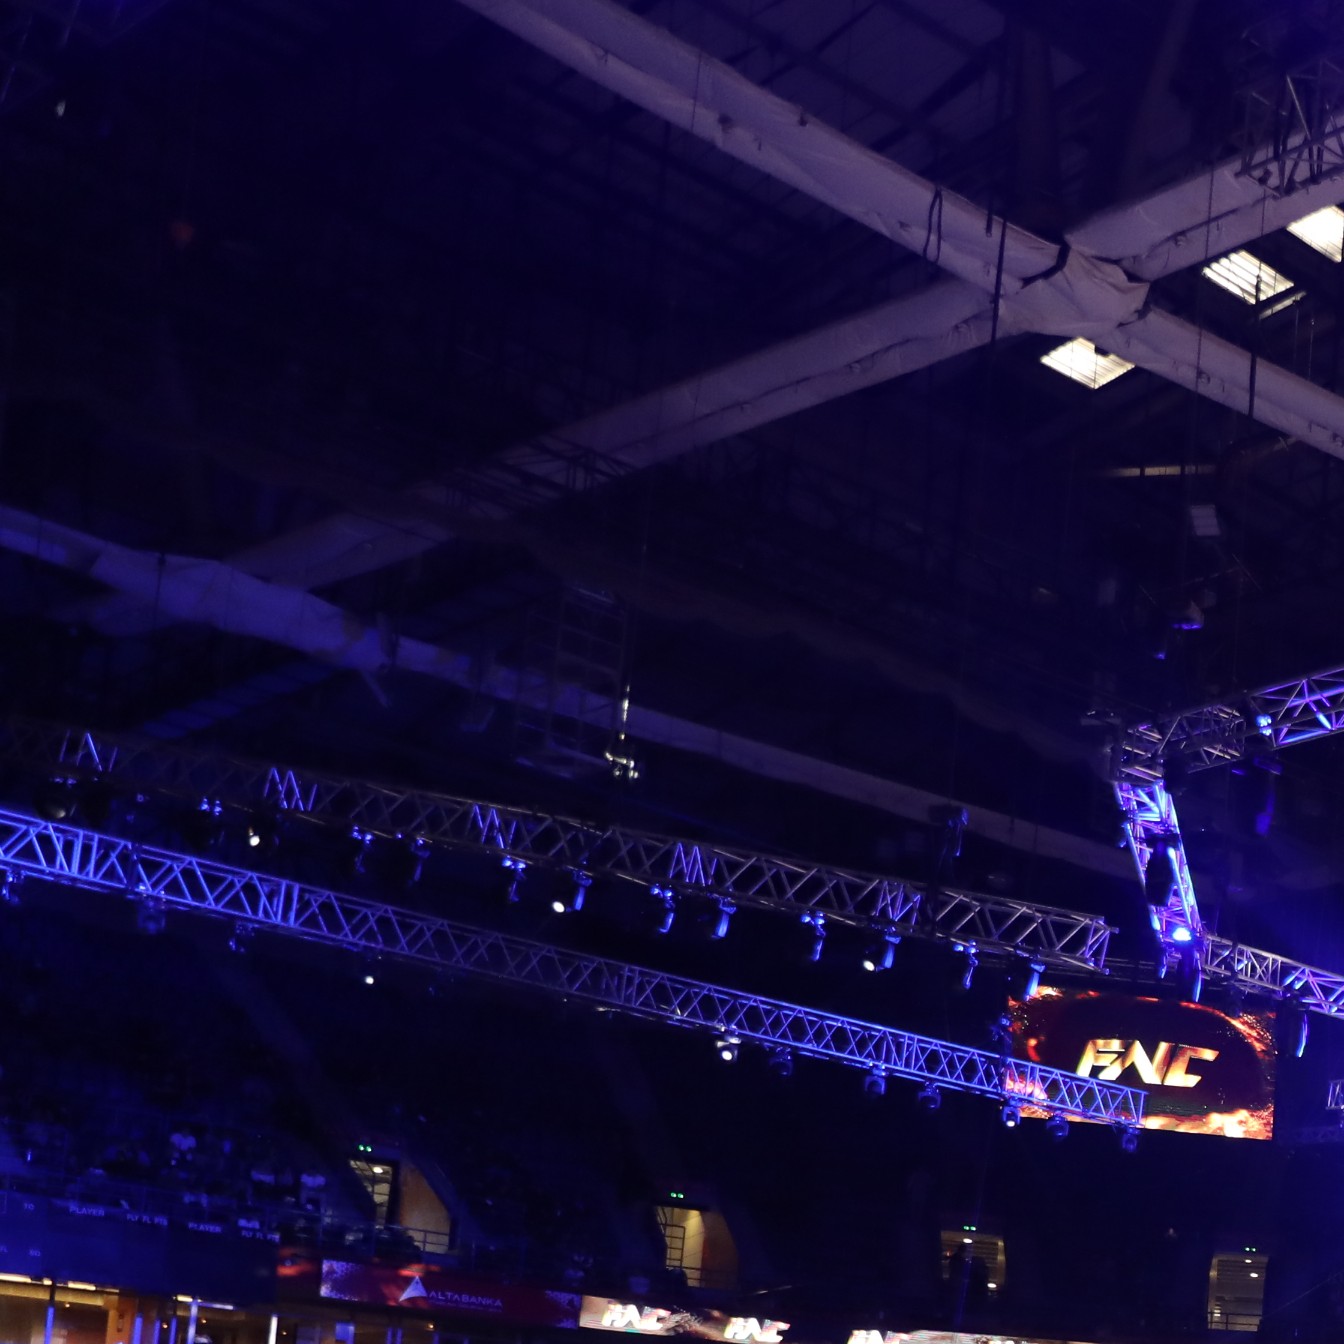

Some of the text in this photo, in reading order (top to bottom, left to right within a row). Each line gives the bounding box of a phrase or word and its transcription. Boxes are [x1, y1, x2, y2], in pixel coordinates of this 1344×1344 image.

[1076, 1038, 1219, 1088] FNC
[69, 1205, 105, 1218] PLAYER
[188, 1222, 222, 1234] PLAYER
[429, 1290, 504, 1308] ALTABANKA
[601, 1302, 671, 1331] FNC
[723, 1316, 790, 1344] FNC
